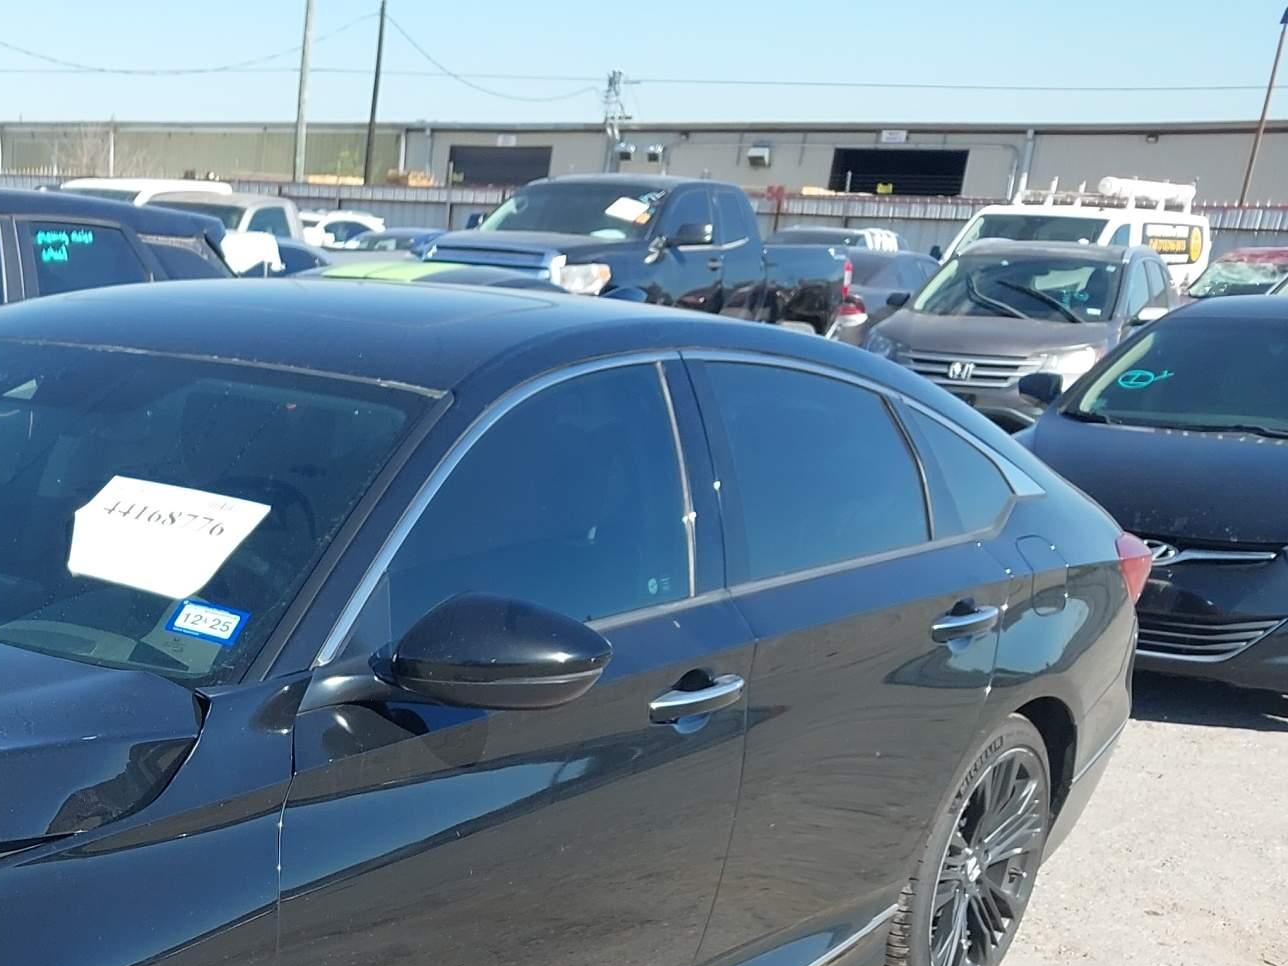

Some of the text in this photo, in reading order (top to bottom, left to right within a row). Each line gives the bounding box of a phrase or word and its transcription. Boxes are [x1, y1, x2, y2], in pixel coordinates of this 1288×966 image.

[103, 501, 225, 536] 44168776
[182, 612, 203, 626] 12
[209, 618, 232, 633] 25
